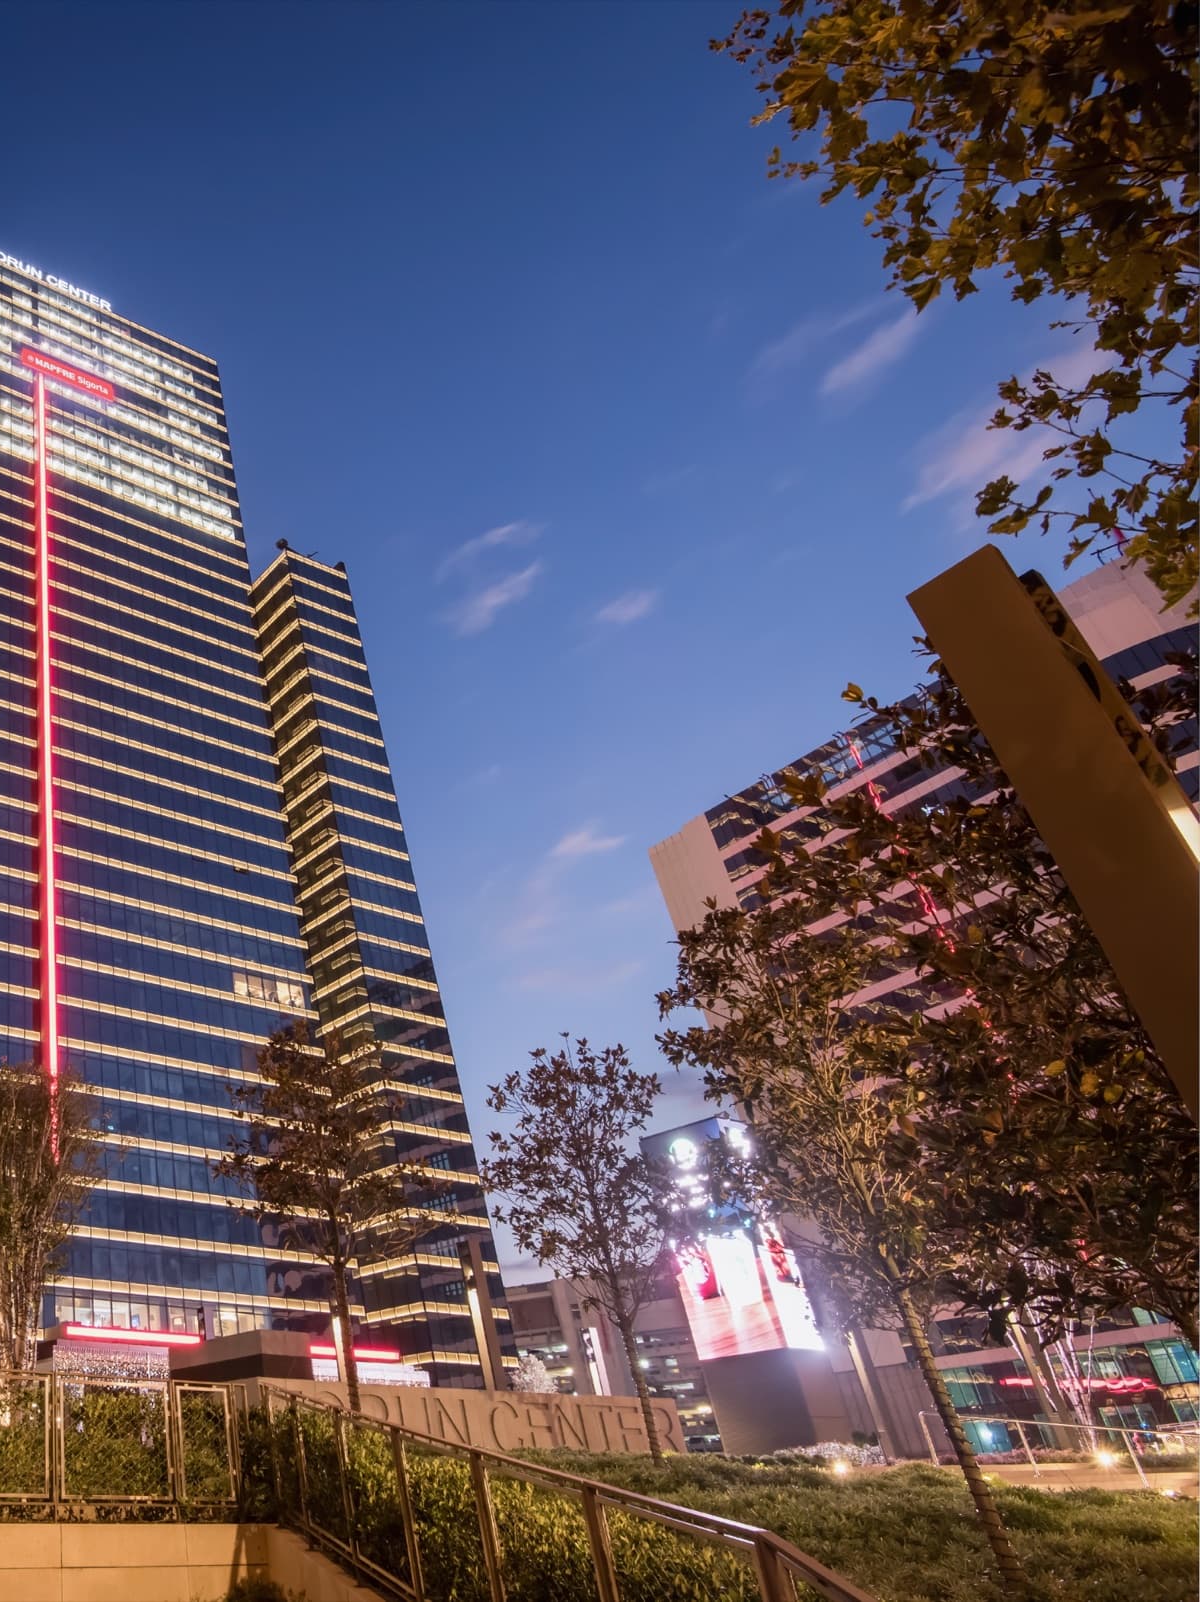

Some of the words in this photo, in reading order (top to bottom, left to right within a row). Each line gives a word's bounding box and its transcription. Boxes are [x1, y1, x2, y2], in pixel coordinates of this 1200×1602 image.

[46, 275, 112, 312] CENTER
[35, 357, 76, 381] MAPFRE
[77, 375, 109, 395] Sigorta
